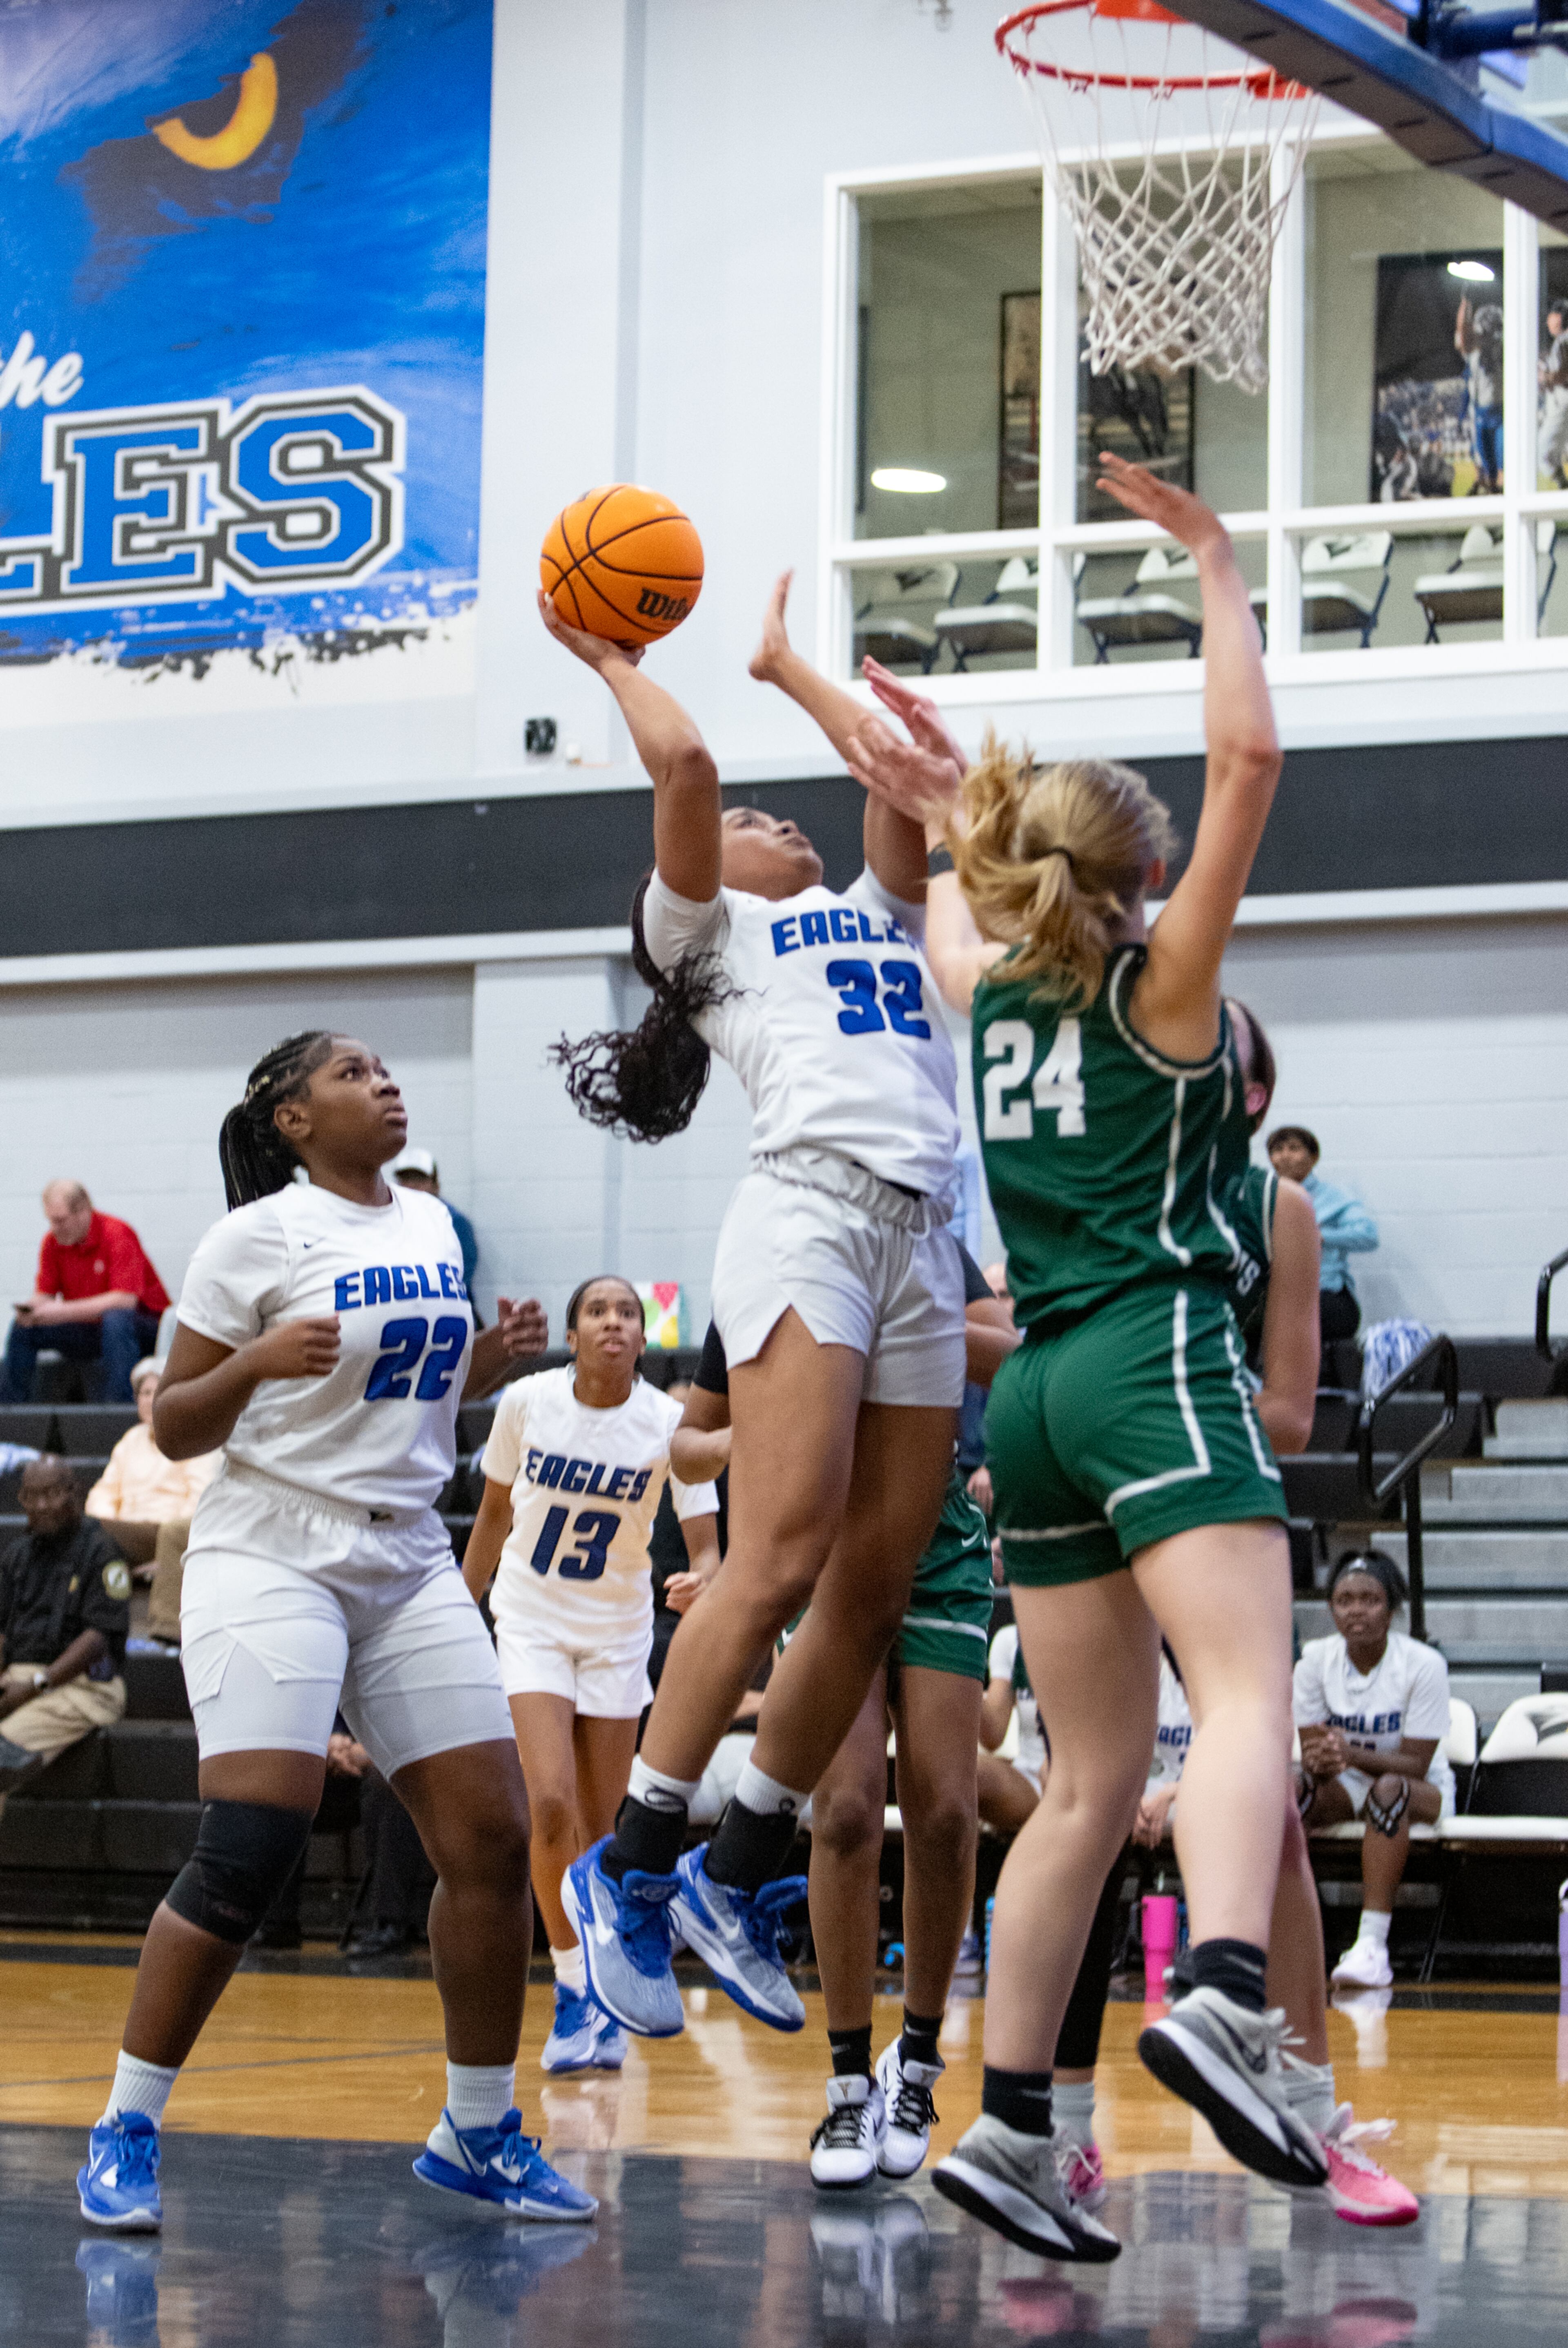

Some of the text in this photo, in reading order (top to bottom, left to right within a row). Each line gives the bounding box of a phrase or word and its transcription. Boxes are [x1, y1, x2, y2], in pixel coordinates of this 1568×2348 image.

[0, 330, 85, 409] he
[826, 959, 931, 1040] 32
[983, 1017, 1086, 1142] 24
[363, 1316, 468, 1401] 22
[525, 1447, 653, 1503] EAGLES
[530, 1505, 621, 1580] 13
